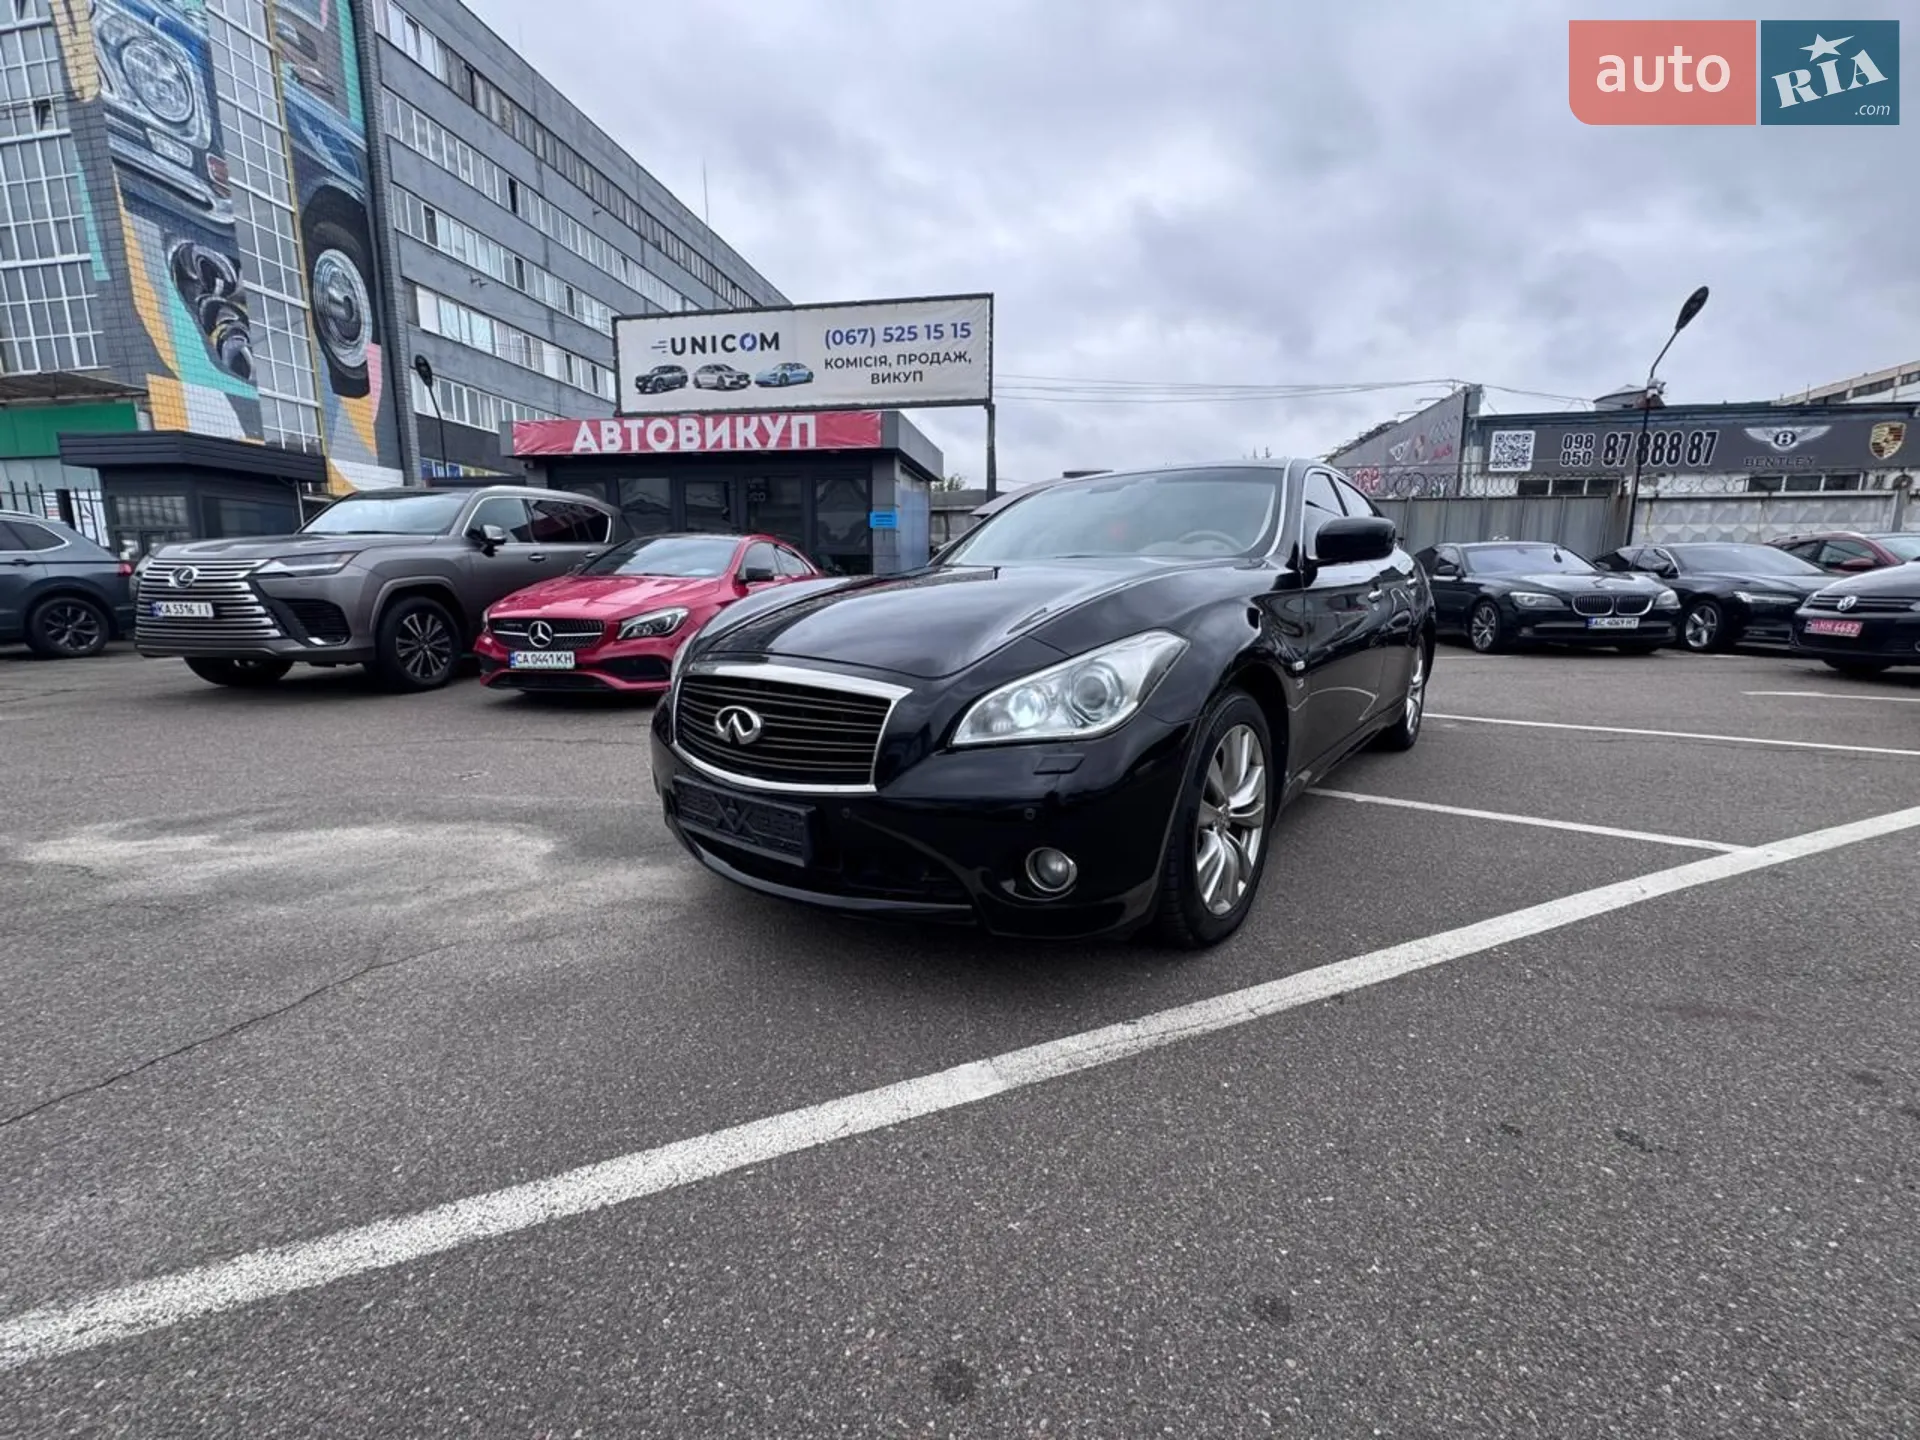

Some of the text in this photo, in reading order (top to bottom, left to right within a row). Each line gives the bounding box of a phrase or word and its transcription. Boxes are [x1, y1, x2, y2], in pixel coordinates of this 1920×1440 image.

[669, 331, 781, 357] UNICOM
[824, 321, 972, 350] (067) 525 15 15
[823, 350, 973, 371] КОМІСІЯ, ПРОДАЖ,
[870, 370, 924, 386] ВИКУП
[572, 414, 816, 453] АВТОВИКУП
[1562, 433, 1595, 450] 098
[1560, 450, 1594, 467] 050
[1602, 429, 1720, 468] 87 888 87
[1743, 455, 1815, 469] BENTLEY
